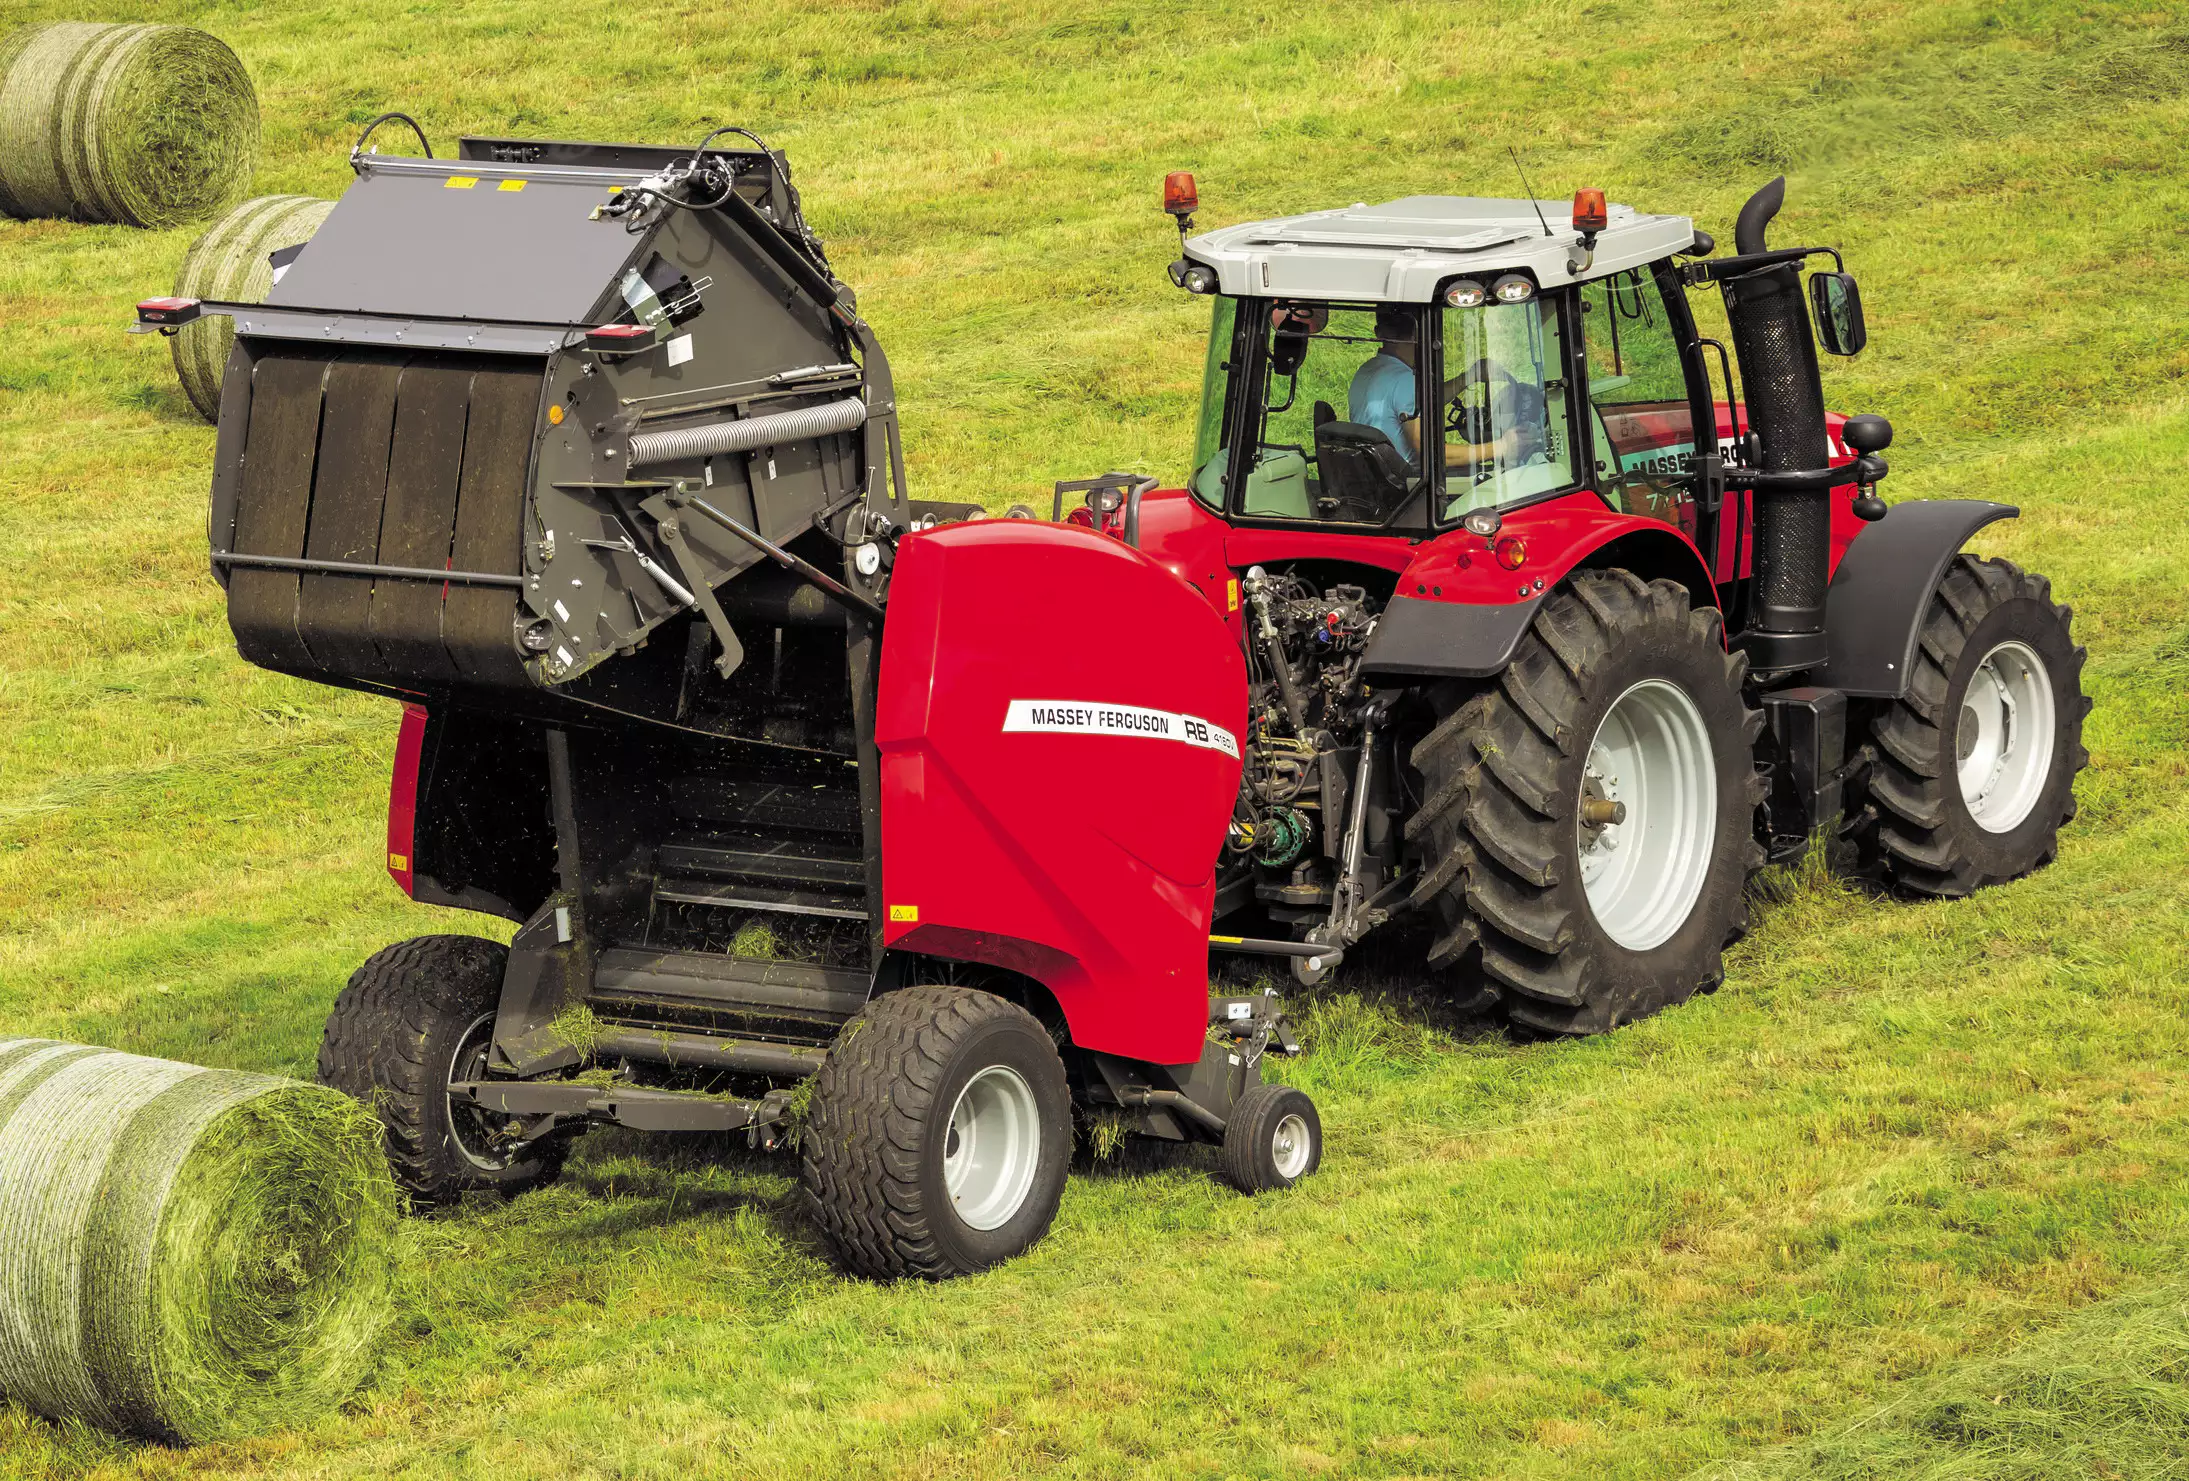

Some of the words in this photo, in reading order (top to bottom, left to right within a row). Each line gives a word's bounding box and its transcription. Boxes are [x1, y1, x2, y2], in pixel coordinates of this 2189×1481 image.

[1031, 708, 1093, 726] MASSEY
[1099, 710, 1169, 734] FERGUSON
[1184, 719, 1209, 742] RB
